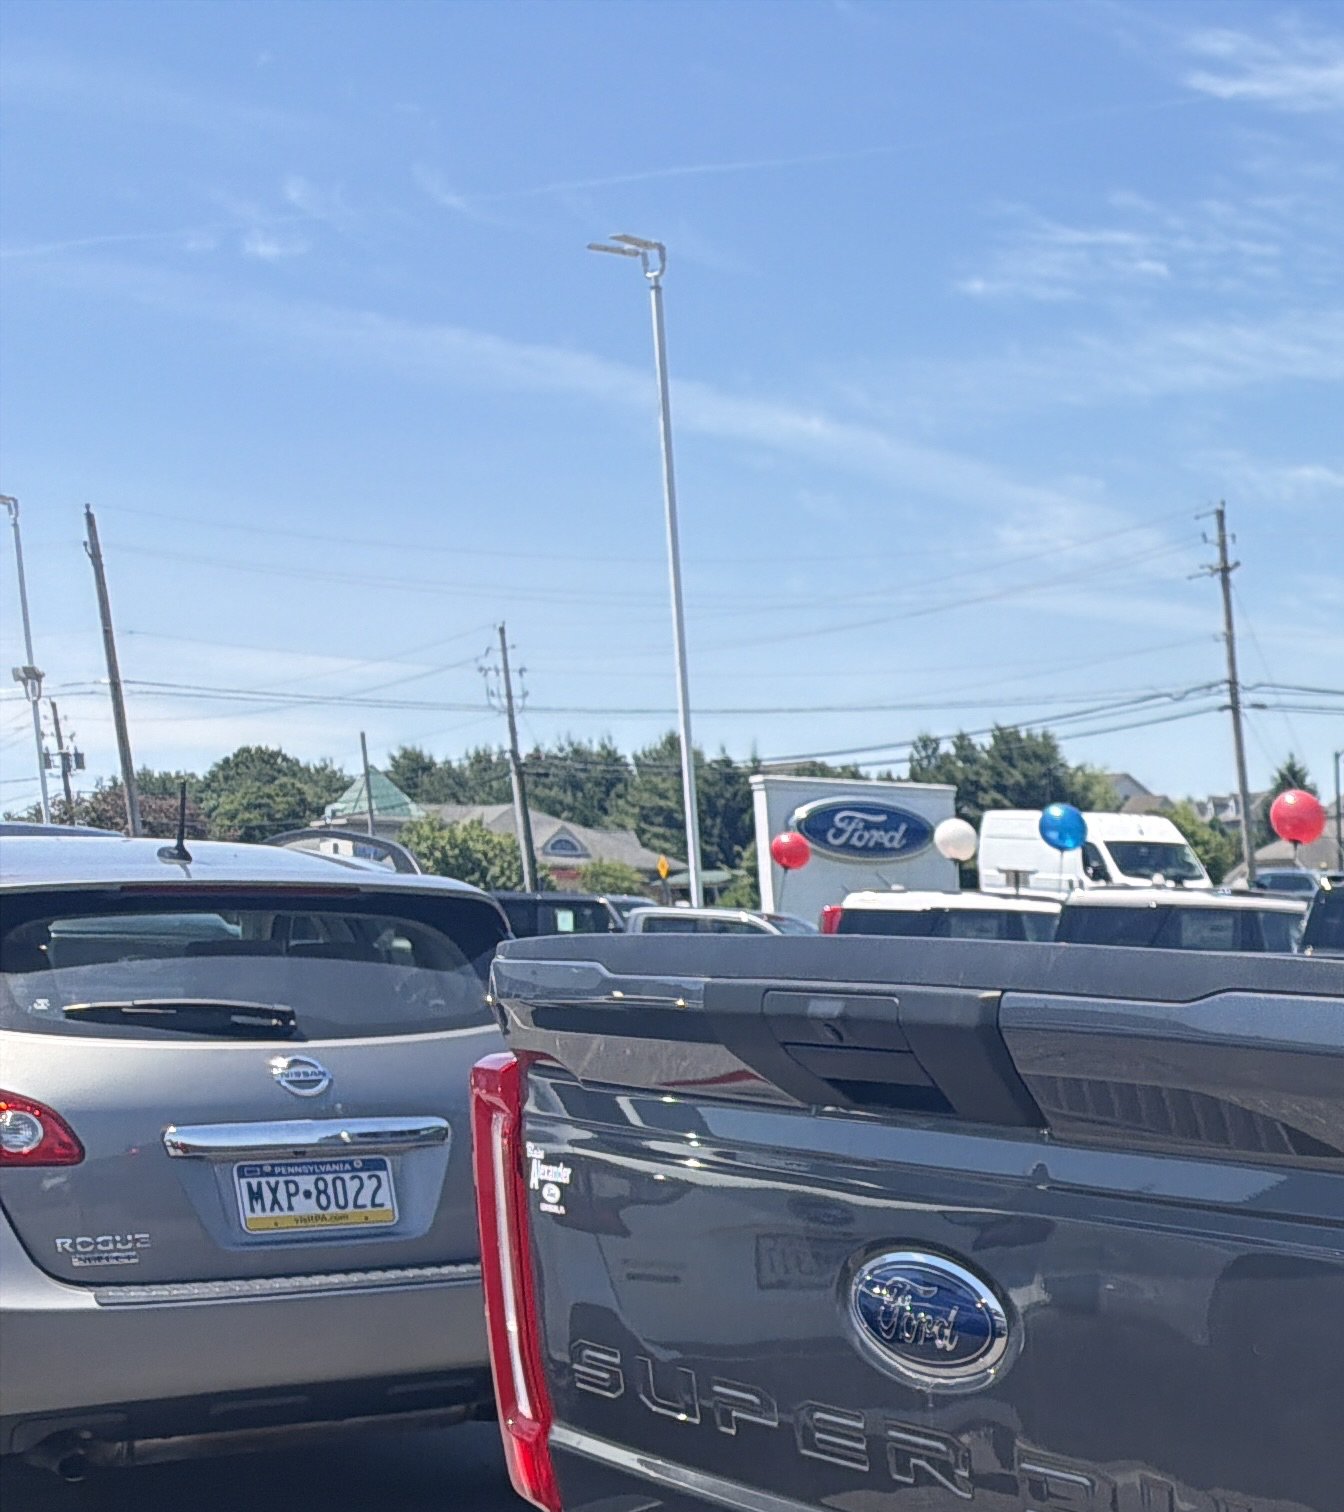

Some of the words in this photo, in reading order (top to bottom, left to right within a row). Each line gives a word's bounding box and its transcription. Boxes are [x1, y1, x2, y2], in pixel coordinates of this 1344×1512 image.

[827, 810, 908, 849] Ford
[280, 1069, 327, 1079] NISSAN
[274, 1163, 351, 1174] PENNSYLVANIA
[530, 1158, 572, 1190] Alexander
[294, 1213, 349, 1224] visitPA.com
[55, 1233, 150, 1253] ROGUE
[879, 1277, 958, 1351] Ford
[571, 1338, 975, 1500] SUPER
